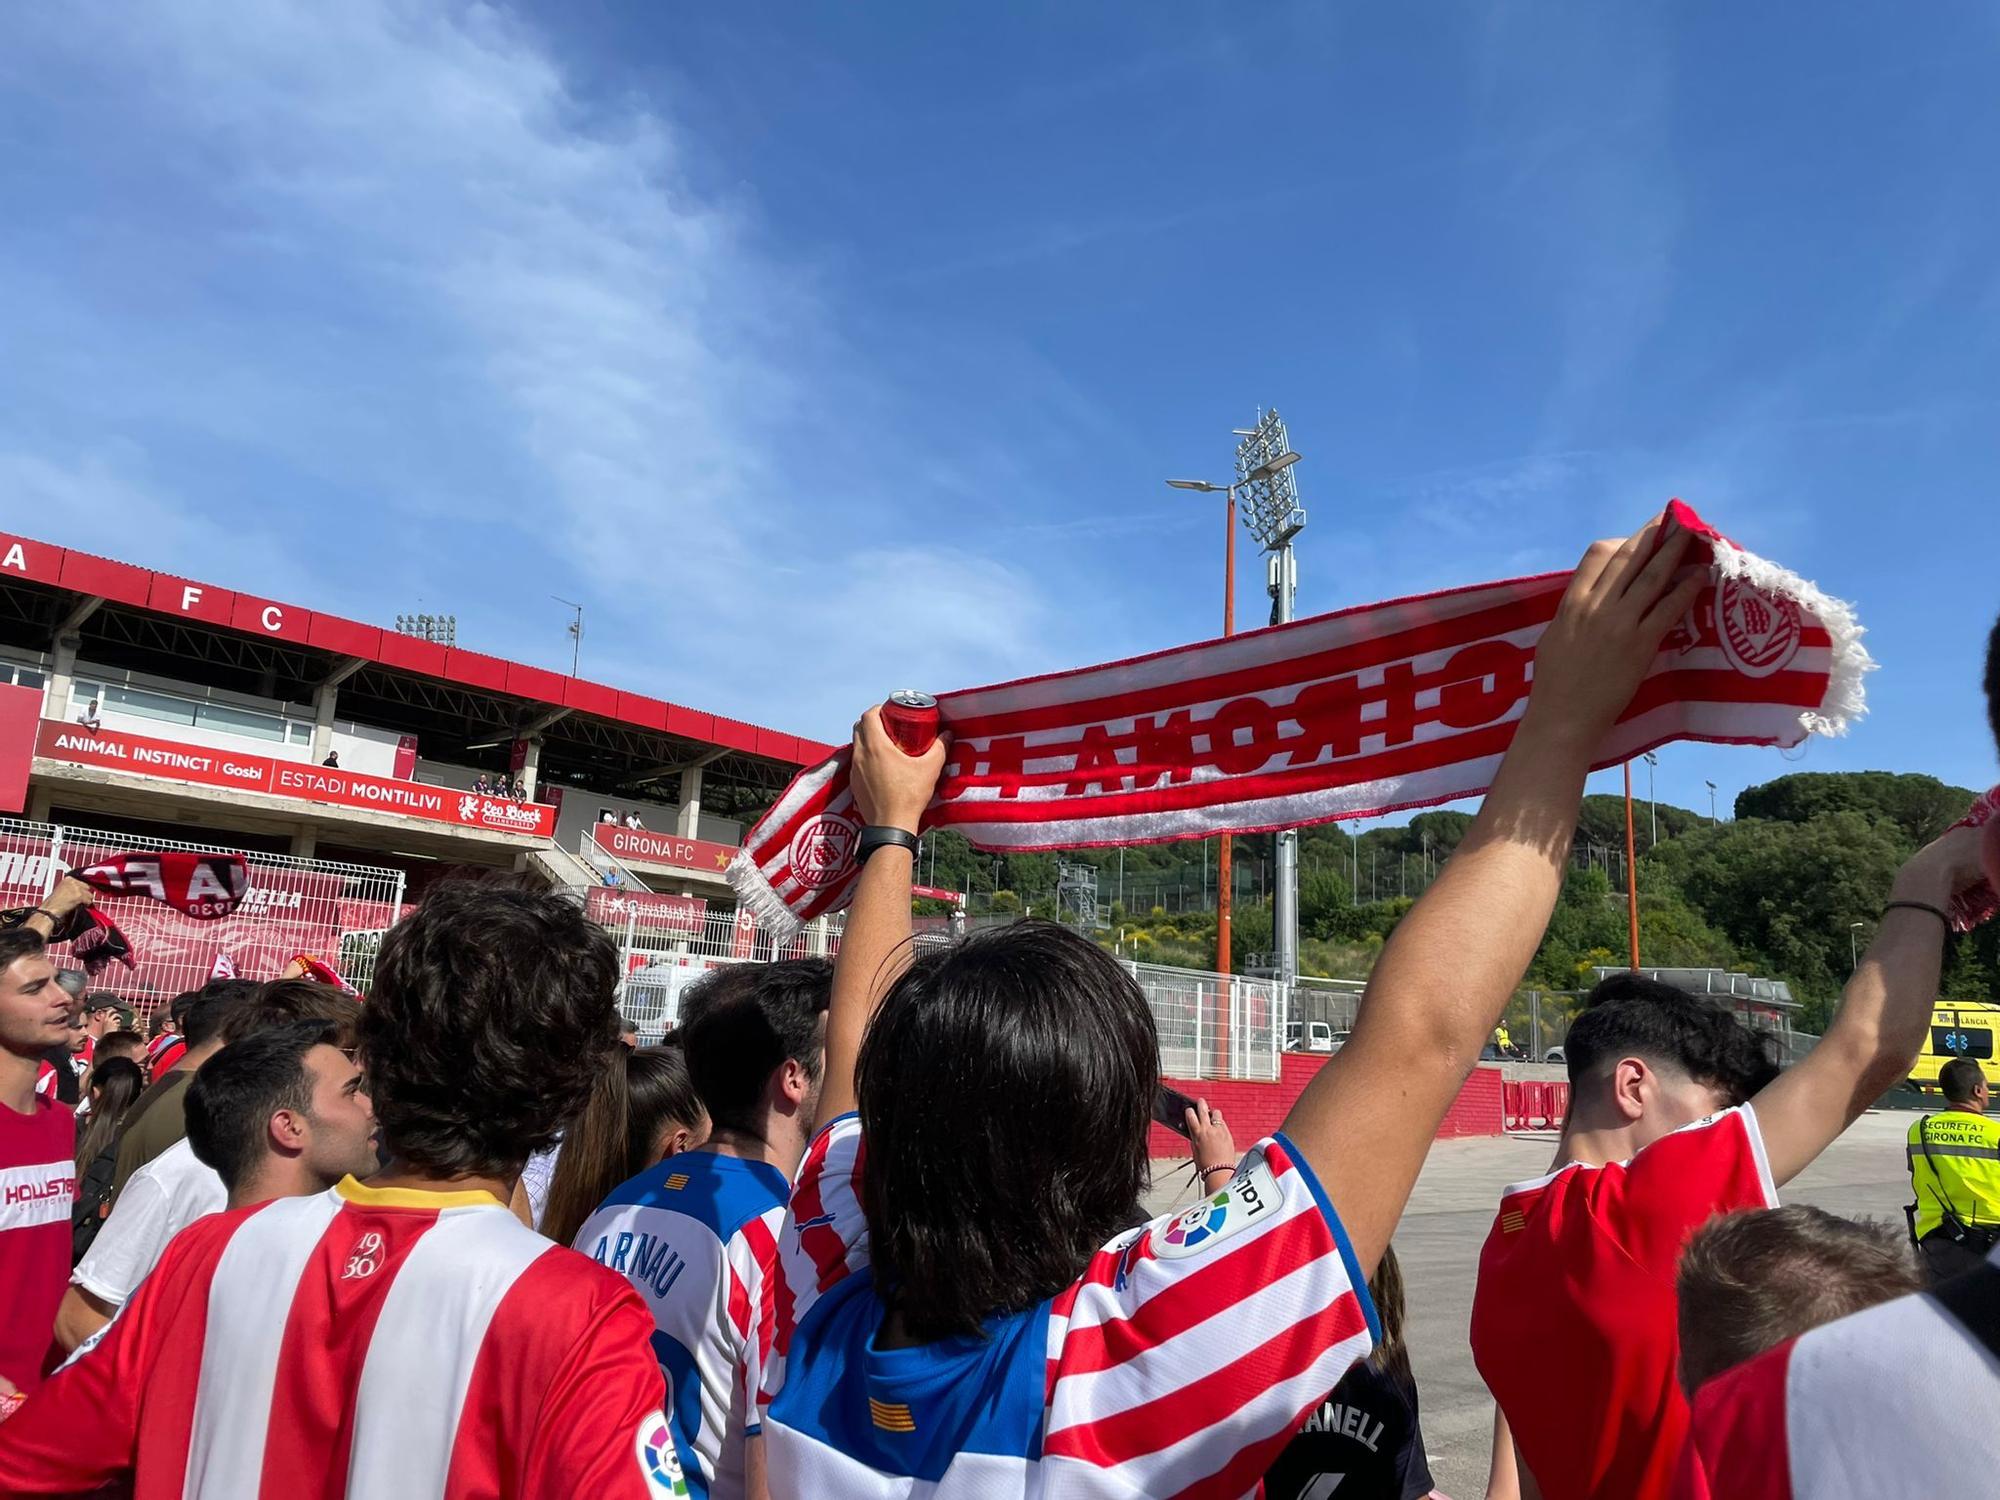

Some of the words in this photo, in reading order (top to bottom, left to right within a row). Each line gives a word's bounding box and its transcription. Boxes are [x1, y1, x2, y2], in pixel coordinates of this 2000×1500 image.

[54, 733, 128, 759] ANIMAL
[132, 746, 212, 773] INSTINCT
[222, 762, 263, 780] Gosbi
[280, 770, 346, 794] ESTADI
[350, 782, 441, 811] MONTILIVI
[613, 833, 671, 858] GIRONA
[674, 843, 694, 861] FC
[1923, 1121, 1985, 1132] SEGURETAT
[1924, 1132, 1964, 1143] GIRONA
[1968, 1134, 1983, 1144] FC
[594, 1231, 686, 1299] ARNAU
[1297, 1401, 1385, 1453] ANELL
